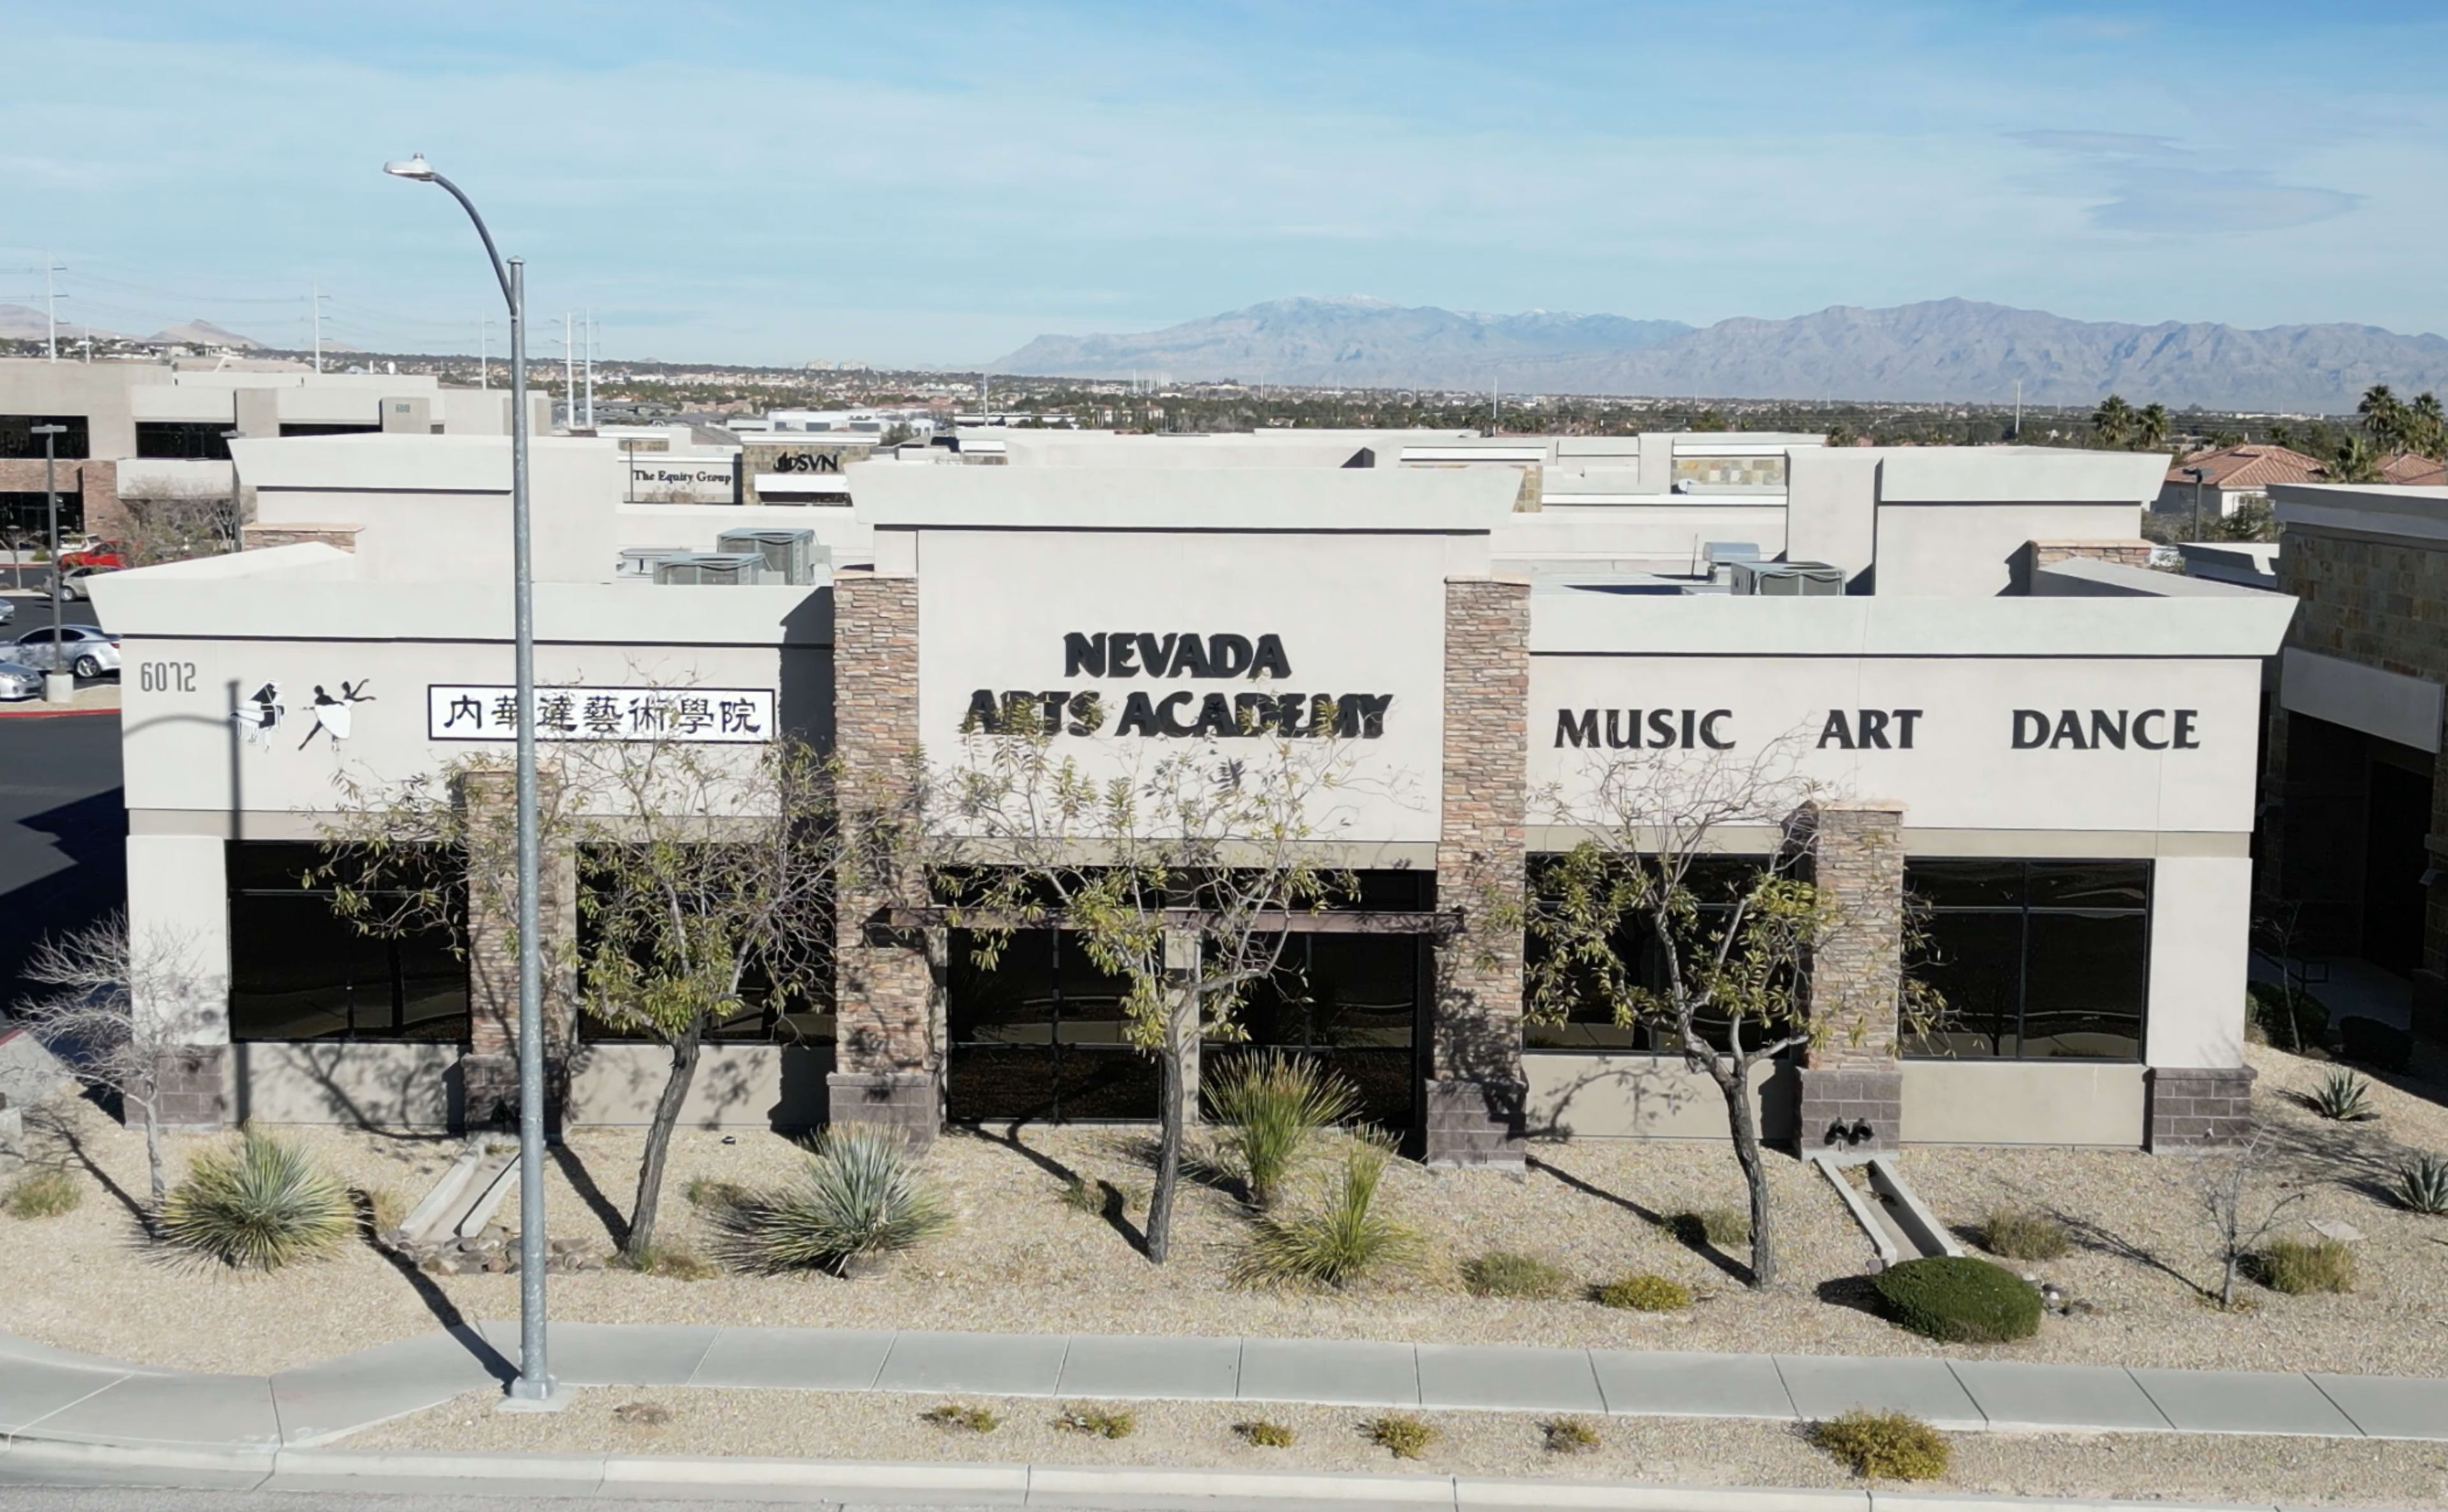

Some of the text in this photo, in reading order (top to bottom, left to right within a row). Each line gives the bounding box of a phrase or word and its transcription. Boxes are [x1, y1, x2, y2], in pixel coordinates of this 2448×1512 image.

[633, 470, 732, 485] The Equity Group
[797, 453, 838, 472] SVN
[1063, 632, 1292, 679] NEVADA
[141, 662, 196, 692] 6072
[963, 689, 1394, 738] ARTS ACADEMY
[1553, 708, 2200, 750] MUSIC ART DANCE
